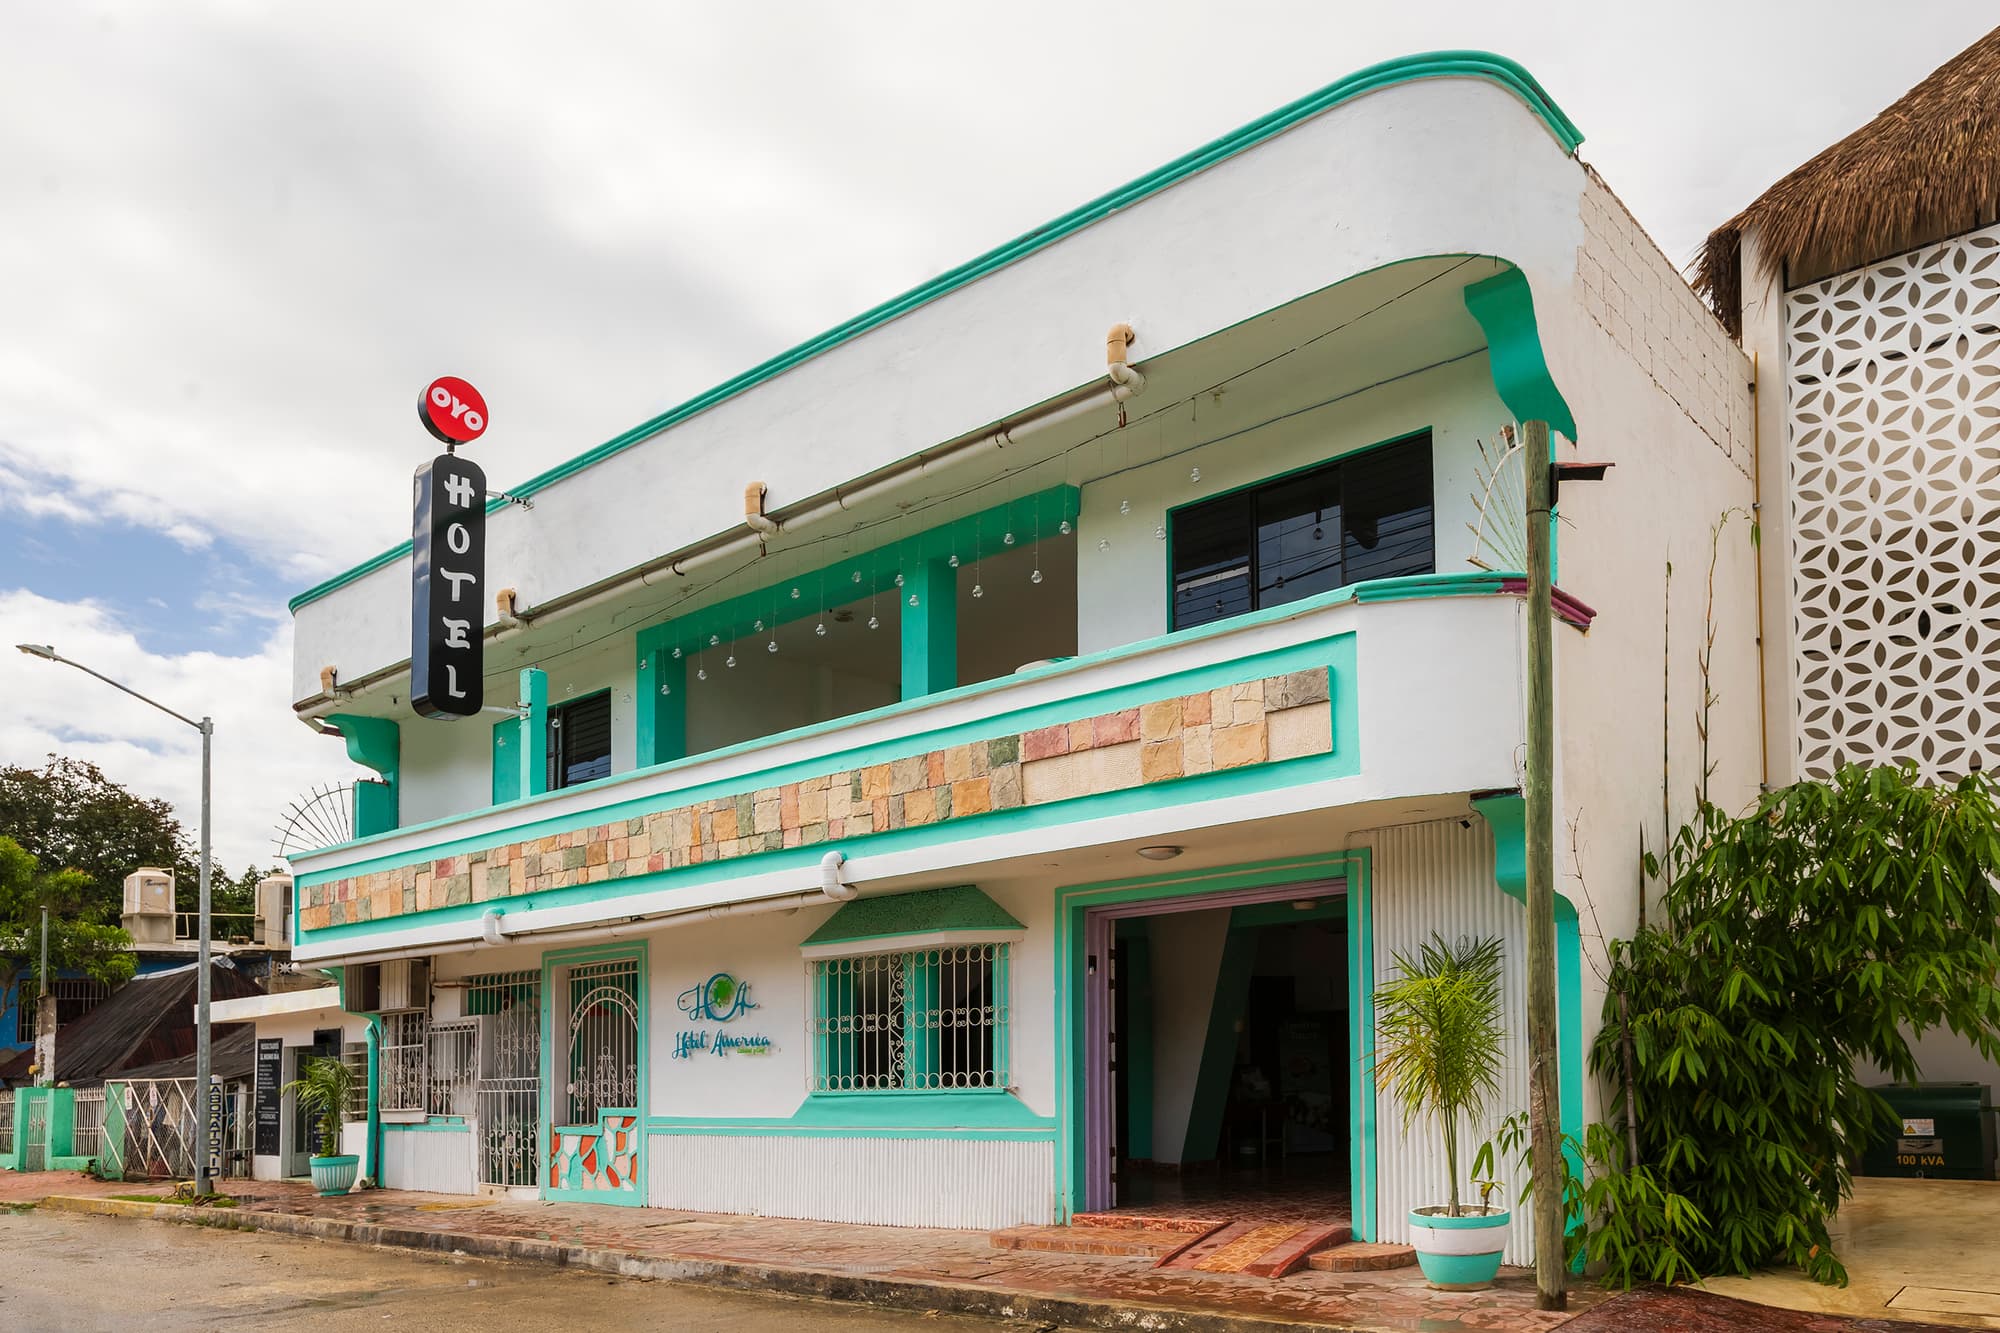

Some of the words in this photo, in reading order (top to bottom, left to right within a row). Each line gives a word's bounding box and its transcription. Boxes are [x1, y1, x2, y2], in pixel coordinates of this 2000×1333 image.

[430, 386, 484, 432] OYO
[439, 473, 476, 698] HOTEL
[671, 1030, 706, 1059] Hotel
[209, 1077, 222, 1177] LABORATORIO
[1897, 1154, 1916, 1166] 100
[1920, 1154, 1945, 1166] kVA
